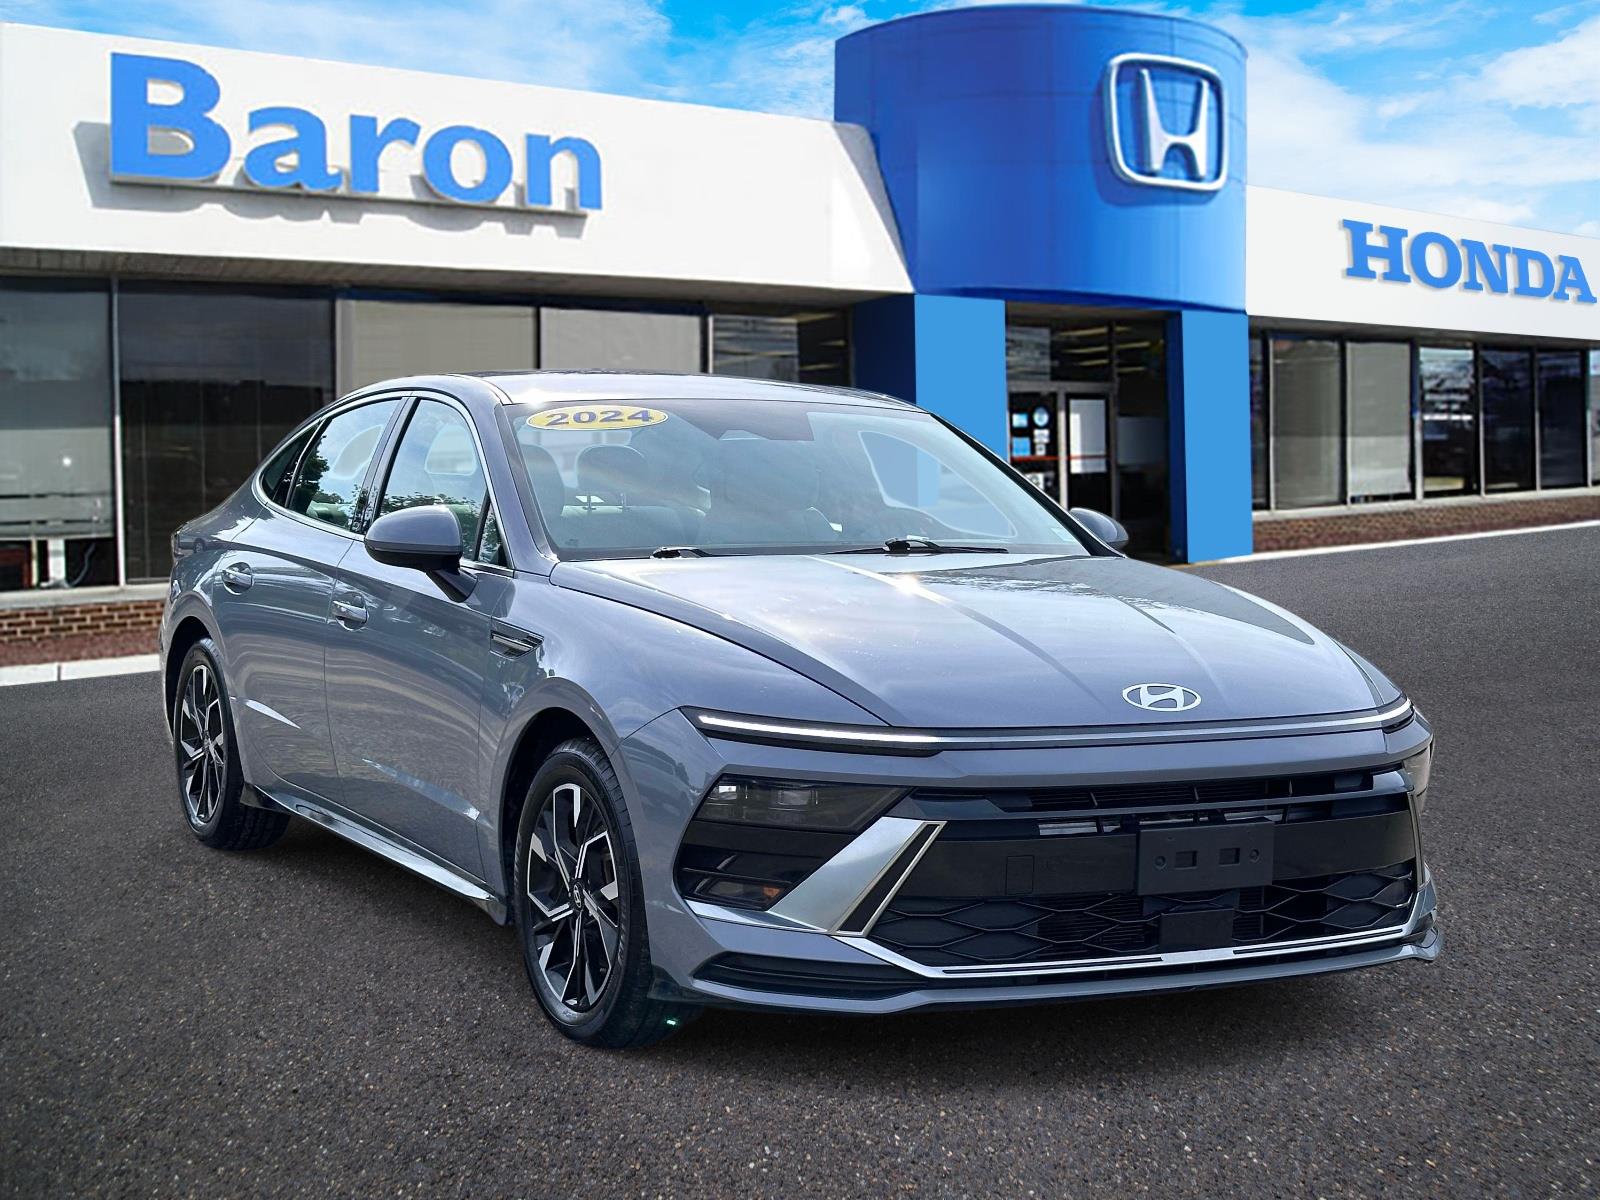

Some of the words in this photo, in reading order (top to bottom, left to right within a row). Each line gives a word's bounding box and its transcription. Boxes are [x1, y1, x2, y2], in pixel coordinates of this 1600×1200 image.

[110, 52, 603, 210] Baron
[1342, 218, 1598, 304] HONDA
[545, 410, 654, 427] 2024
